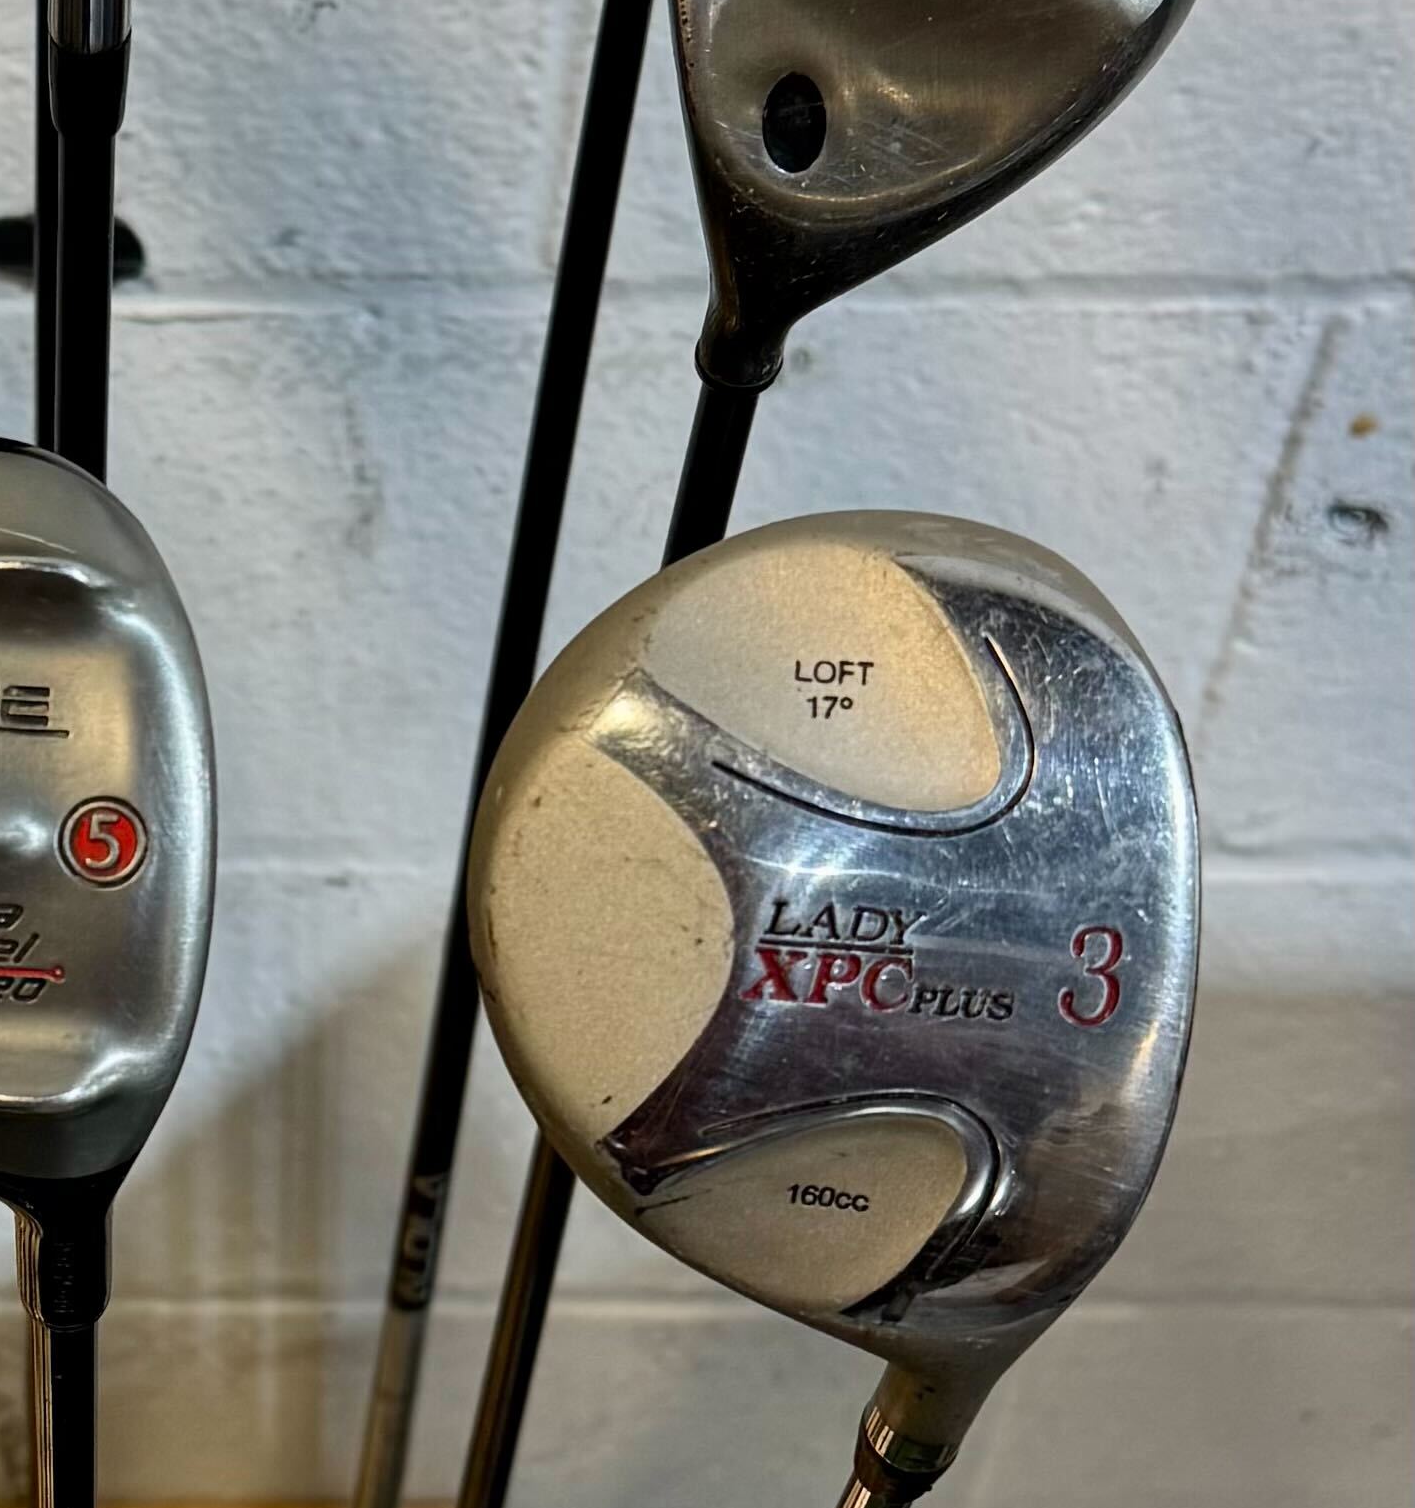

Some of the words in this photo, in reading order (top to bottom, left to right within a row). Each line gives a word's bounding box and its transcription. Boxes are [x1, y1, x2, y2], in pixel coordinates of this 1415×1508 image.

[794, 659, 874, 687] LOFT
[85, 813, 120, 870] 5
[762, 900, 925, 944] LADY
[1059, 924, 1124, 1028] 3
[786, 1183, 870, 1214] 160cc
